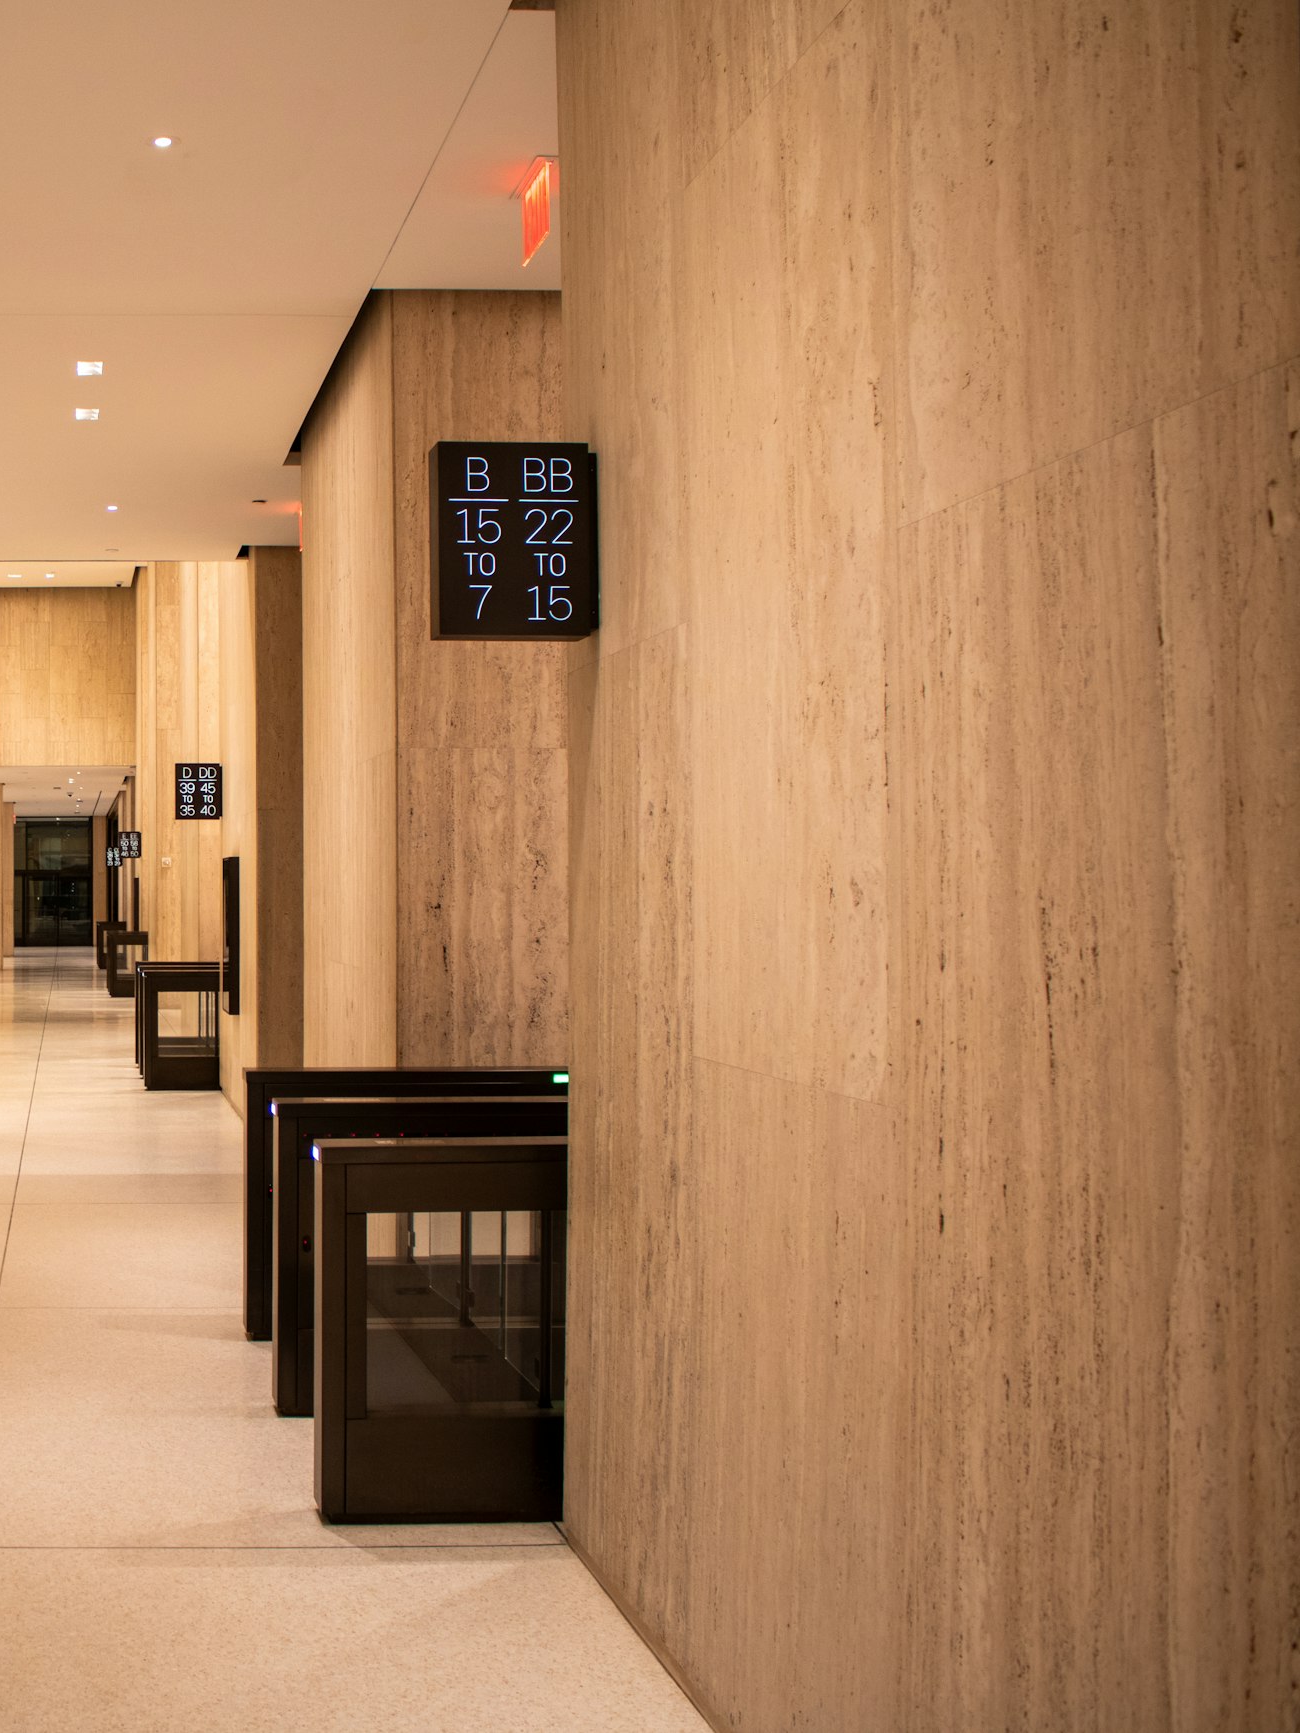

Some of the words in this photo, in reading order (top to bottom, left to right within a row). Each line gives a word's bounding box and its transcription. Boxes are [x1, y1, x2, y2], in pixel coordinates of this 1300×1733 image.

[466, 456, 490, 492] B
[523, 457, 574, 493] BB
[456, 508, 502, 544] 15
[524, 508, 574, 545] 22
[463, 552, 496, 577] TO
[533, 552, 567, 577] TO
[469, 584, 493, 620] 7
[527, 585, 573, 621] 15
[182, 766, 192, 779] D
[198, 766, 217, 779] DD
[179, 782, 196, 794] 39
[200, 782, 216, 794] 45
[182, 795, 193, 803] TO
[202, 795, 214, 803] TO
[179, 804, 196, 817] 35
[200, 804, 217, 817] 40
